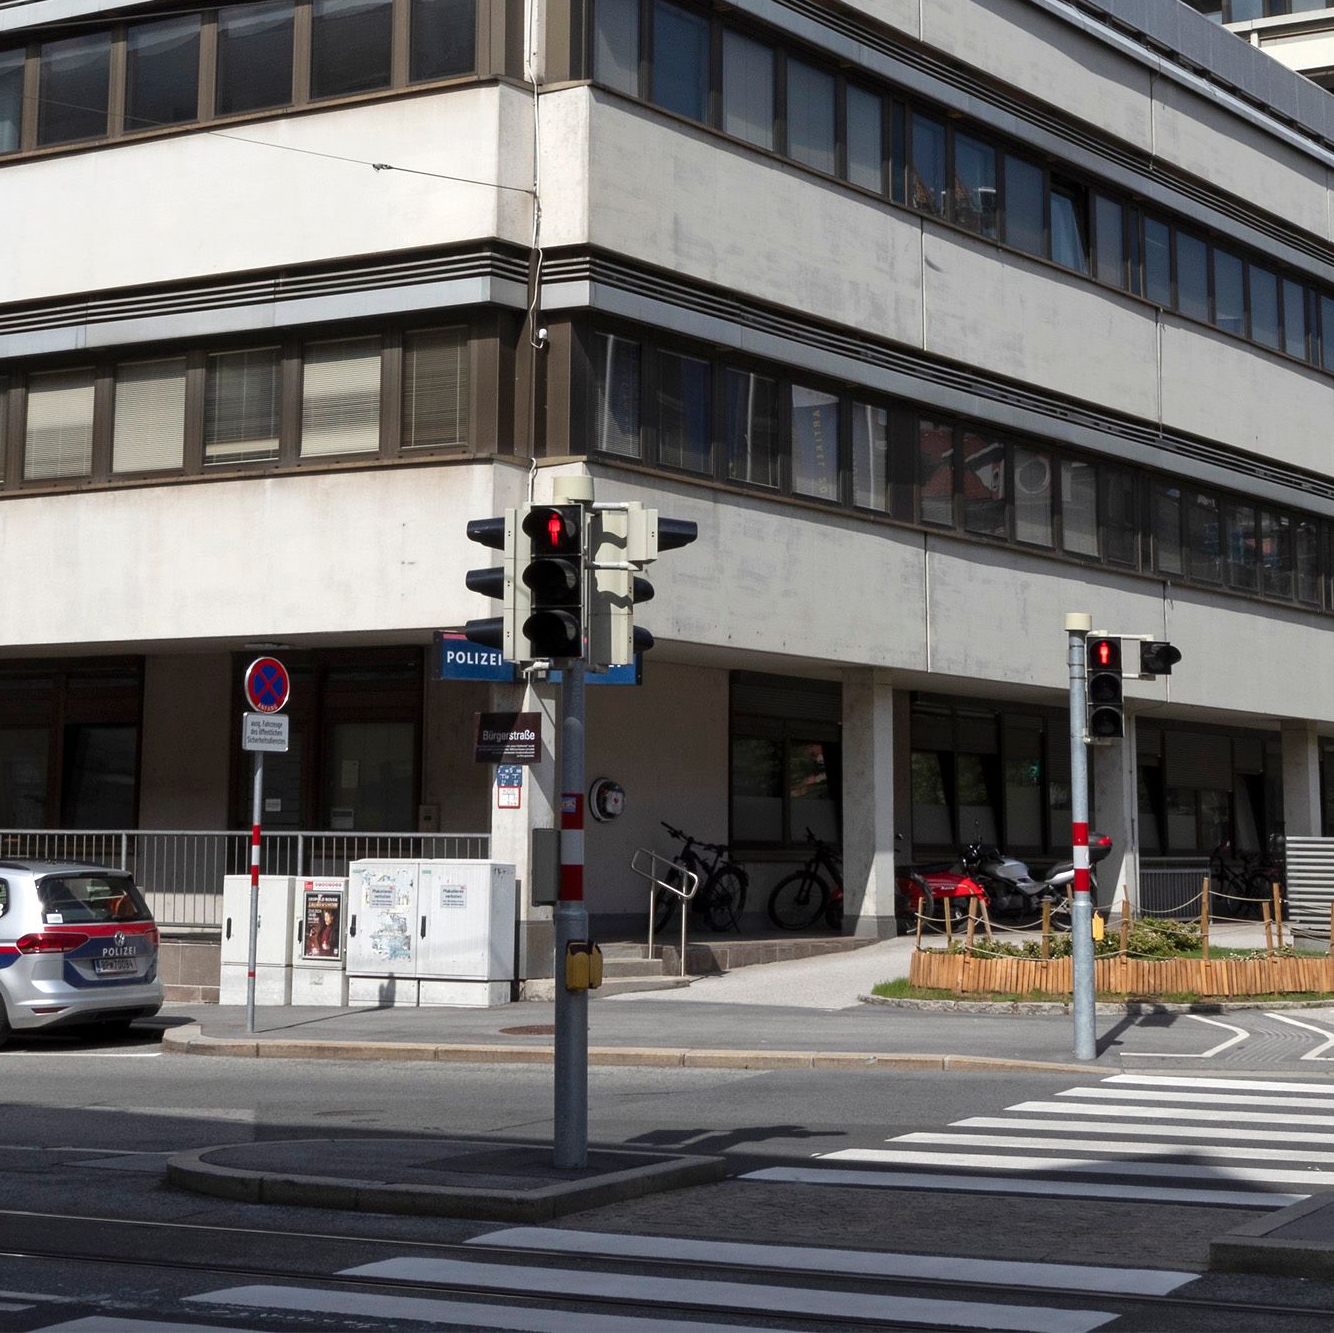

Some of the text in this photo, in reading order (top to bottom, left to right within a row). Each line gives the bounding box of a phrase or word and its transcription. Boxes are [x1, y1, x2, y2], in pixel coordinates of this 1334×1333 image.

[446, 651, 502, 666] POLIZEI
[482, 729, 536, 743] Bürgerstraße
[102, 946, 137, 957] POLIZEI
